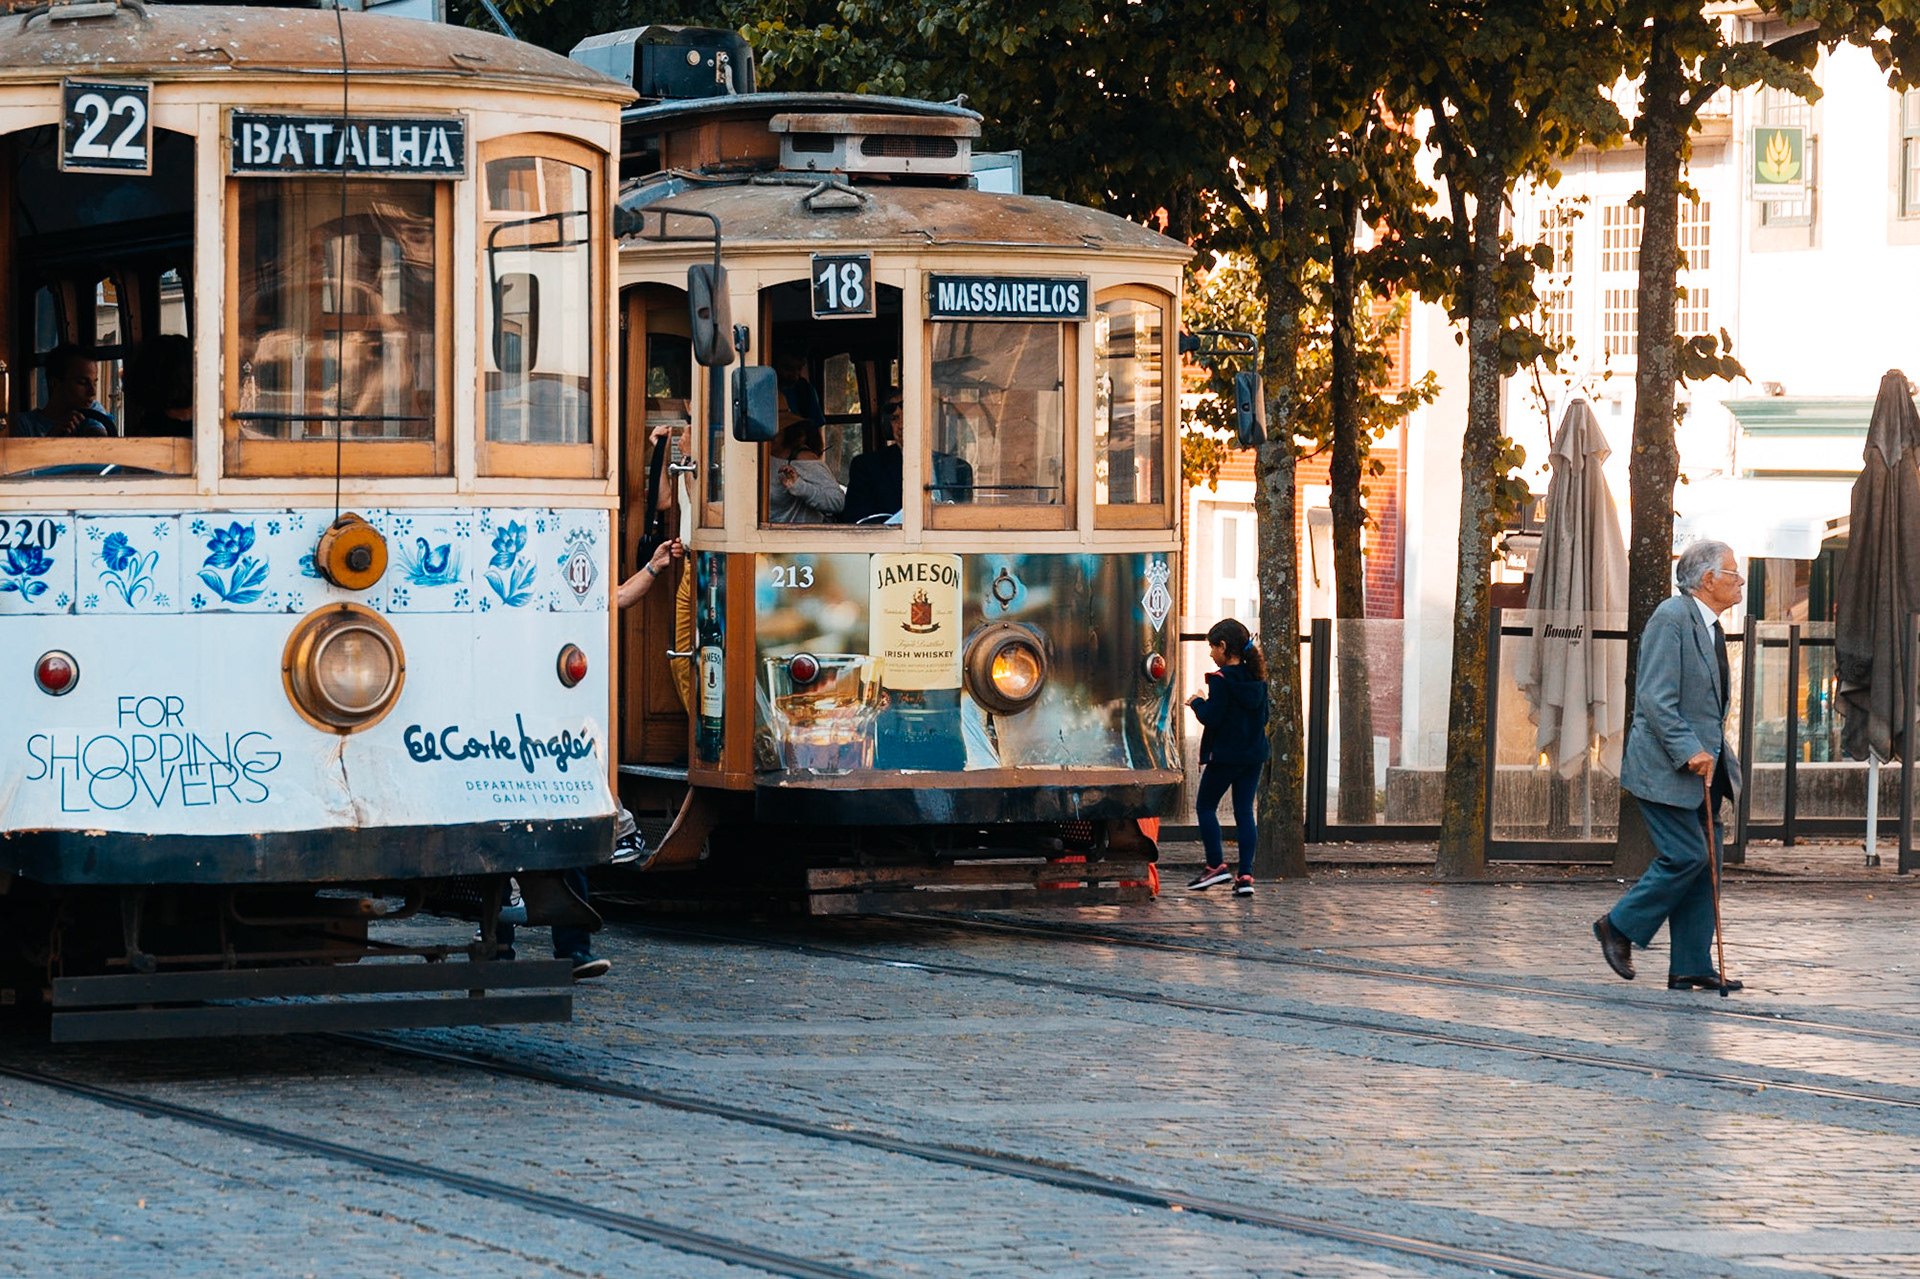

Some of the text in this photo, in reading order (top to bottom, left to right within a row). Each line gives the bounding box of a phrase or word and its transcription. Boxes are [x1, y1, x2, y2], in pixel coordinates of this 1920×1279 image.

[72, 93, 147, 161] 22
[242, 122, 455, 168] BATALHA
[819, 262, 865, 309] 18
[938, 282, 1080, 313] MASSARELOS
[0, 518, 58, 551] 220
[771, 565, 815, 588] 213
[877, 563, 960, 590] JAMESON
[884, 650, 954, 658] IRISH WHISKEY
[118, 696, 184, 728] FOR
[26, 731, 282, 781] SHOPPING
[403, 724, 442, 763] El
[440, 725, 516, 761] Corte
[61, 759, 269, 812] LOVERS
[466, 780, 594, 791] DEPARTMENT STORES
[492, 794, 525, 804] GAIA
[544, 794, 580, 805] PORTO
